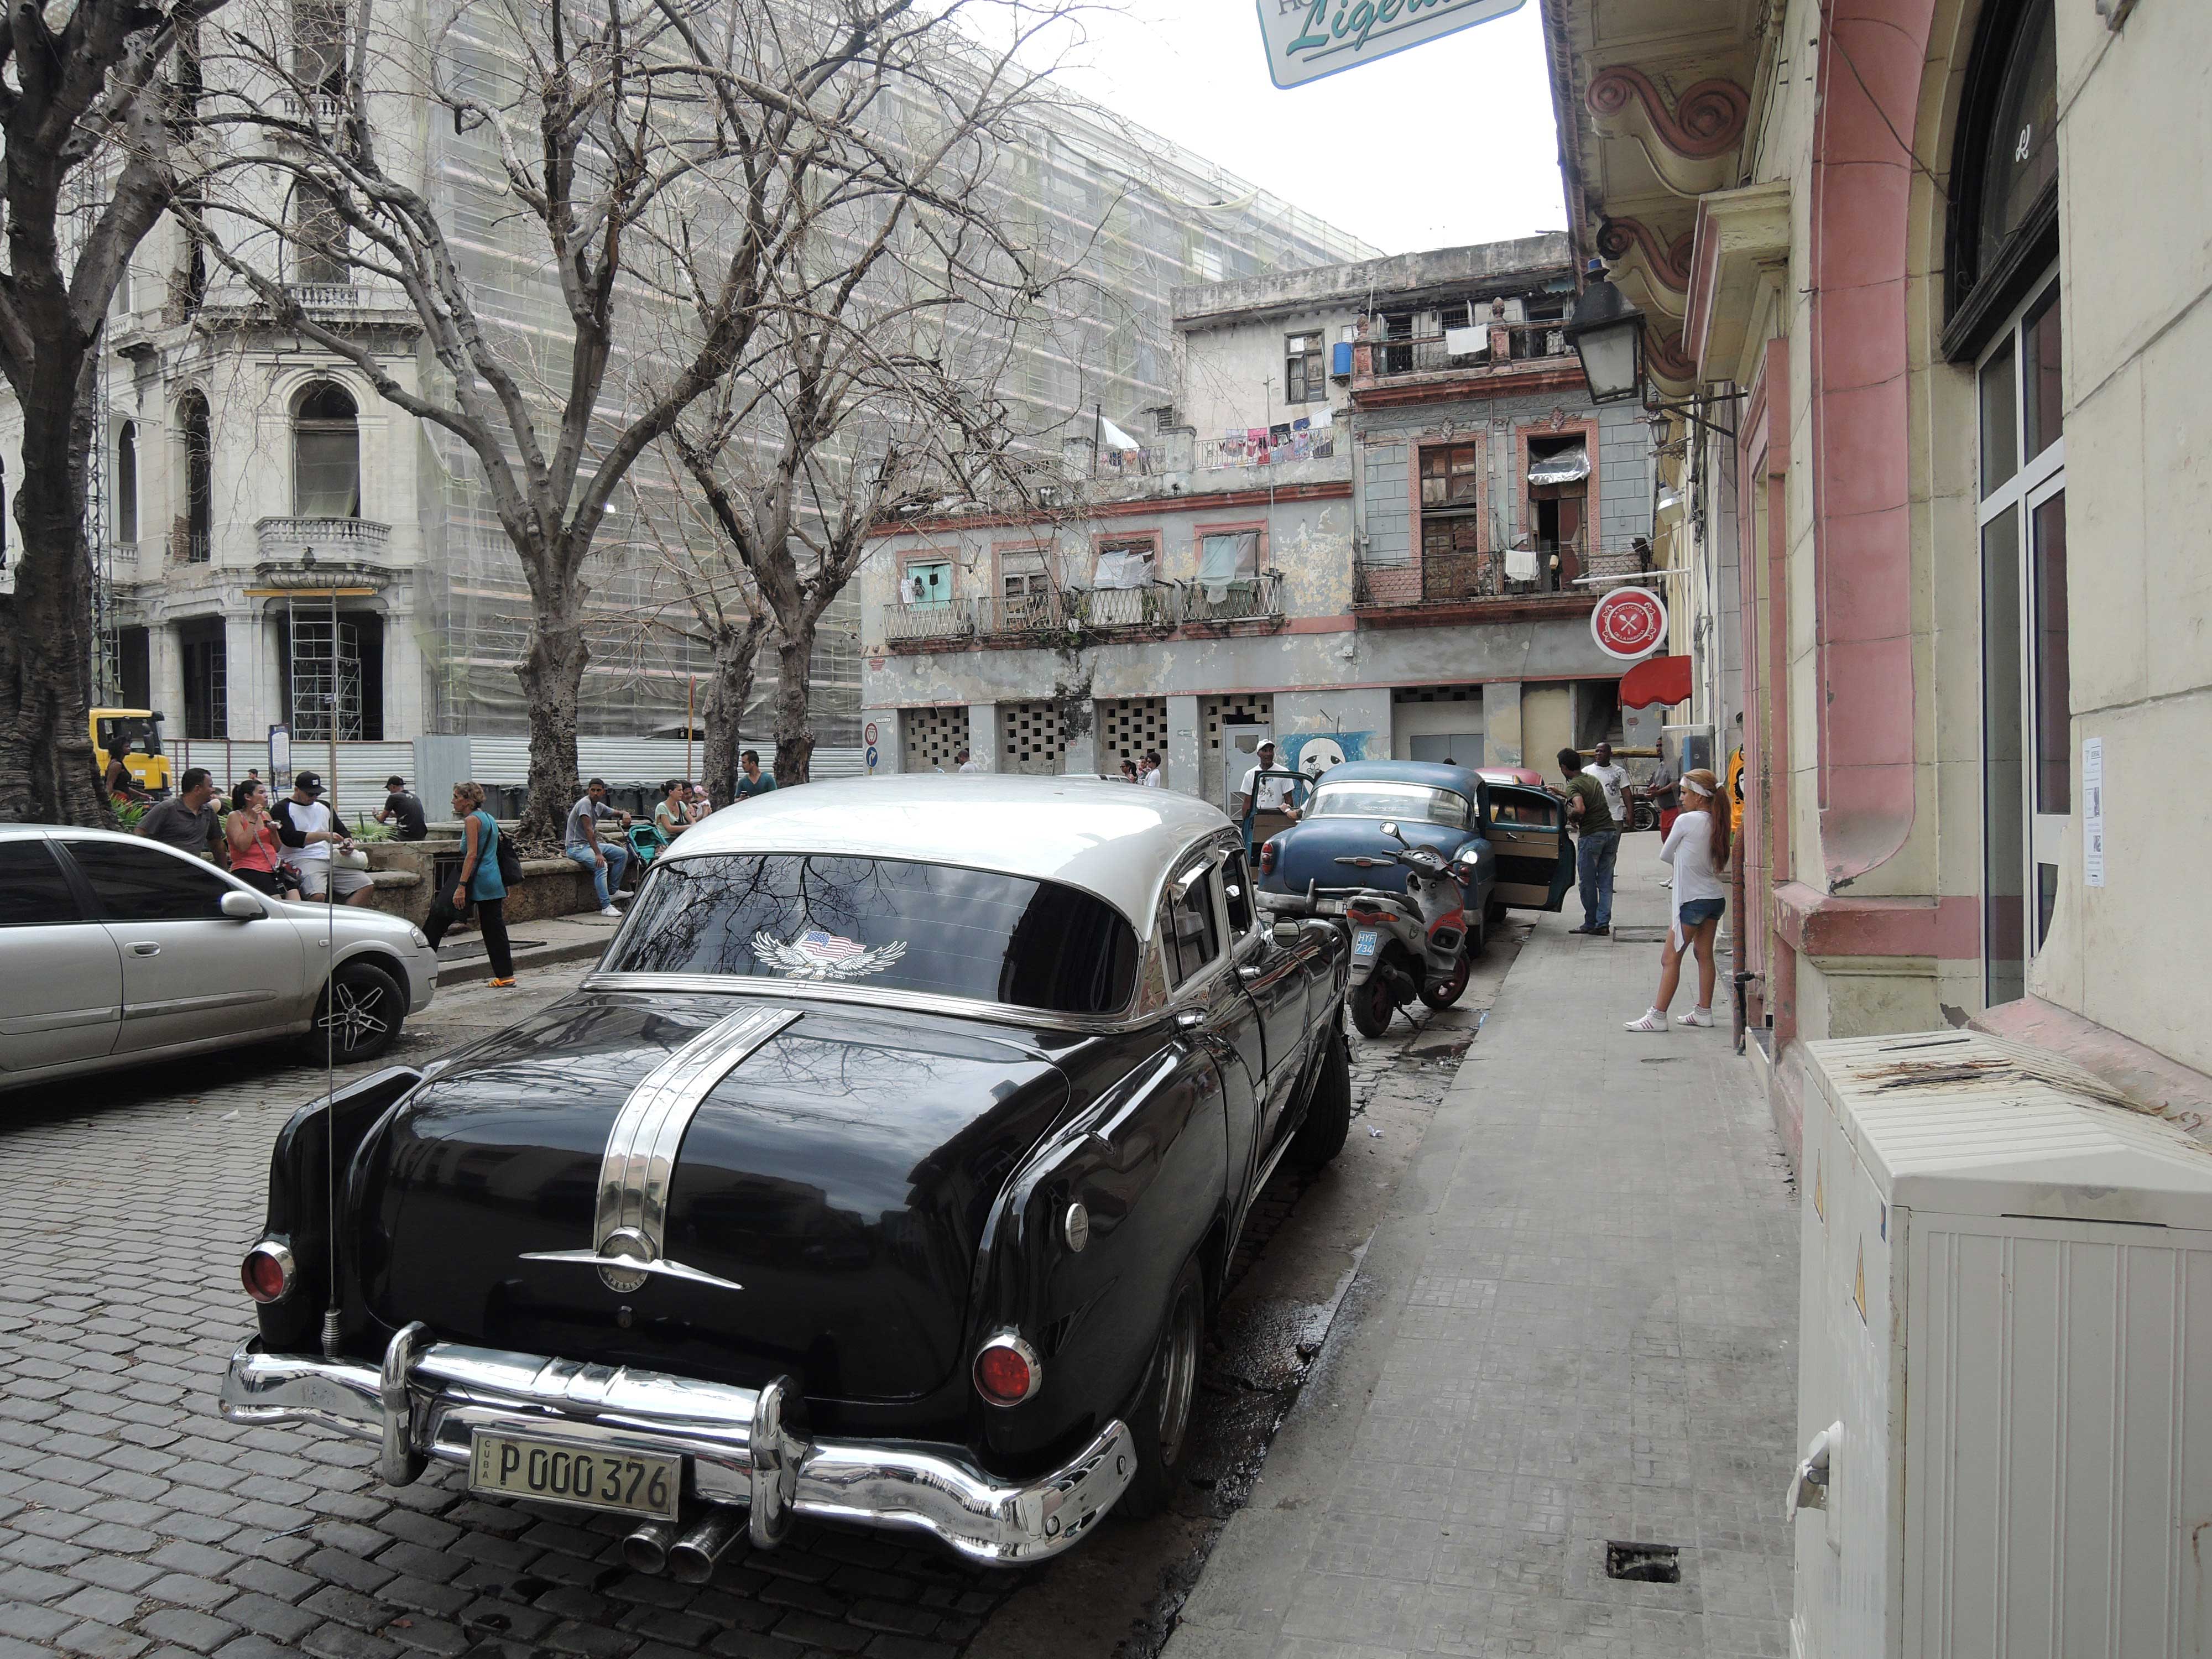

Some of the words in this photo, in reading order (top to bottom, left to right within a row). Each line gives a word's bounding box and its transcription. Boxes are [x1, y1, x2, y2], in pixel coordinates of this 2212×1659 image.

[1357, 944, 1372, 953] 734
[1359, 933, 1376, 942] HYF
[482, 1440, 491, 1478] CUBA
[500, 1444, 520, 1485] P
[601, 1459, 667, 1507] 376
